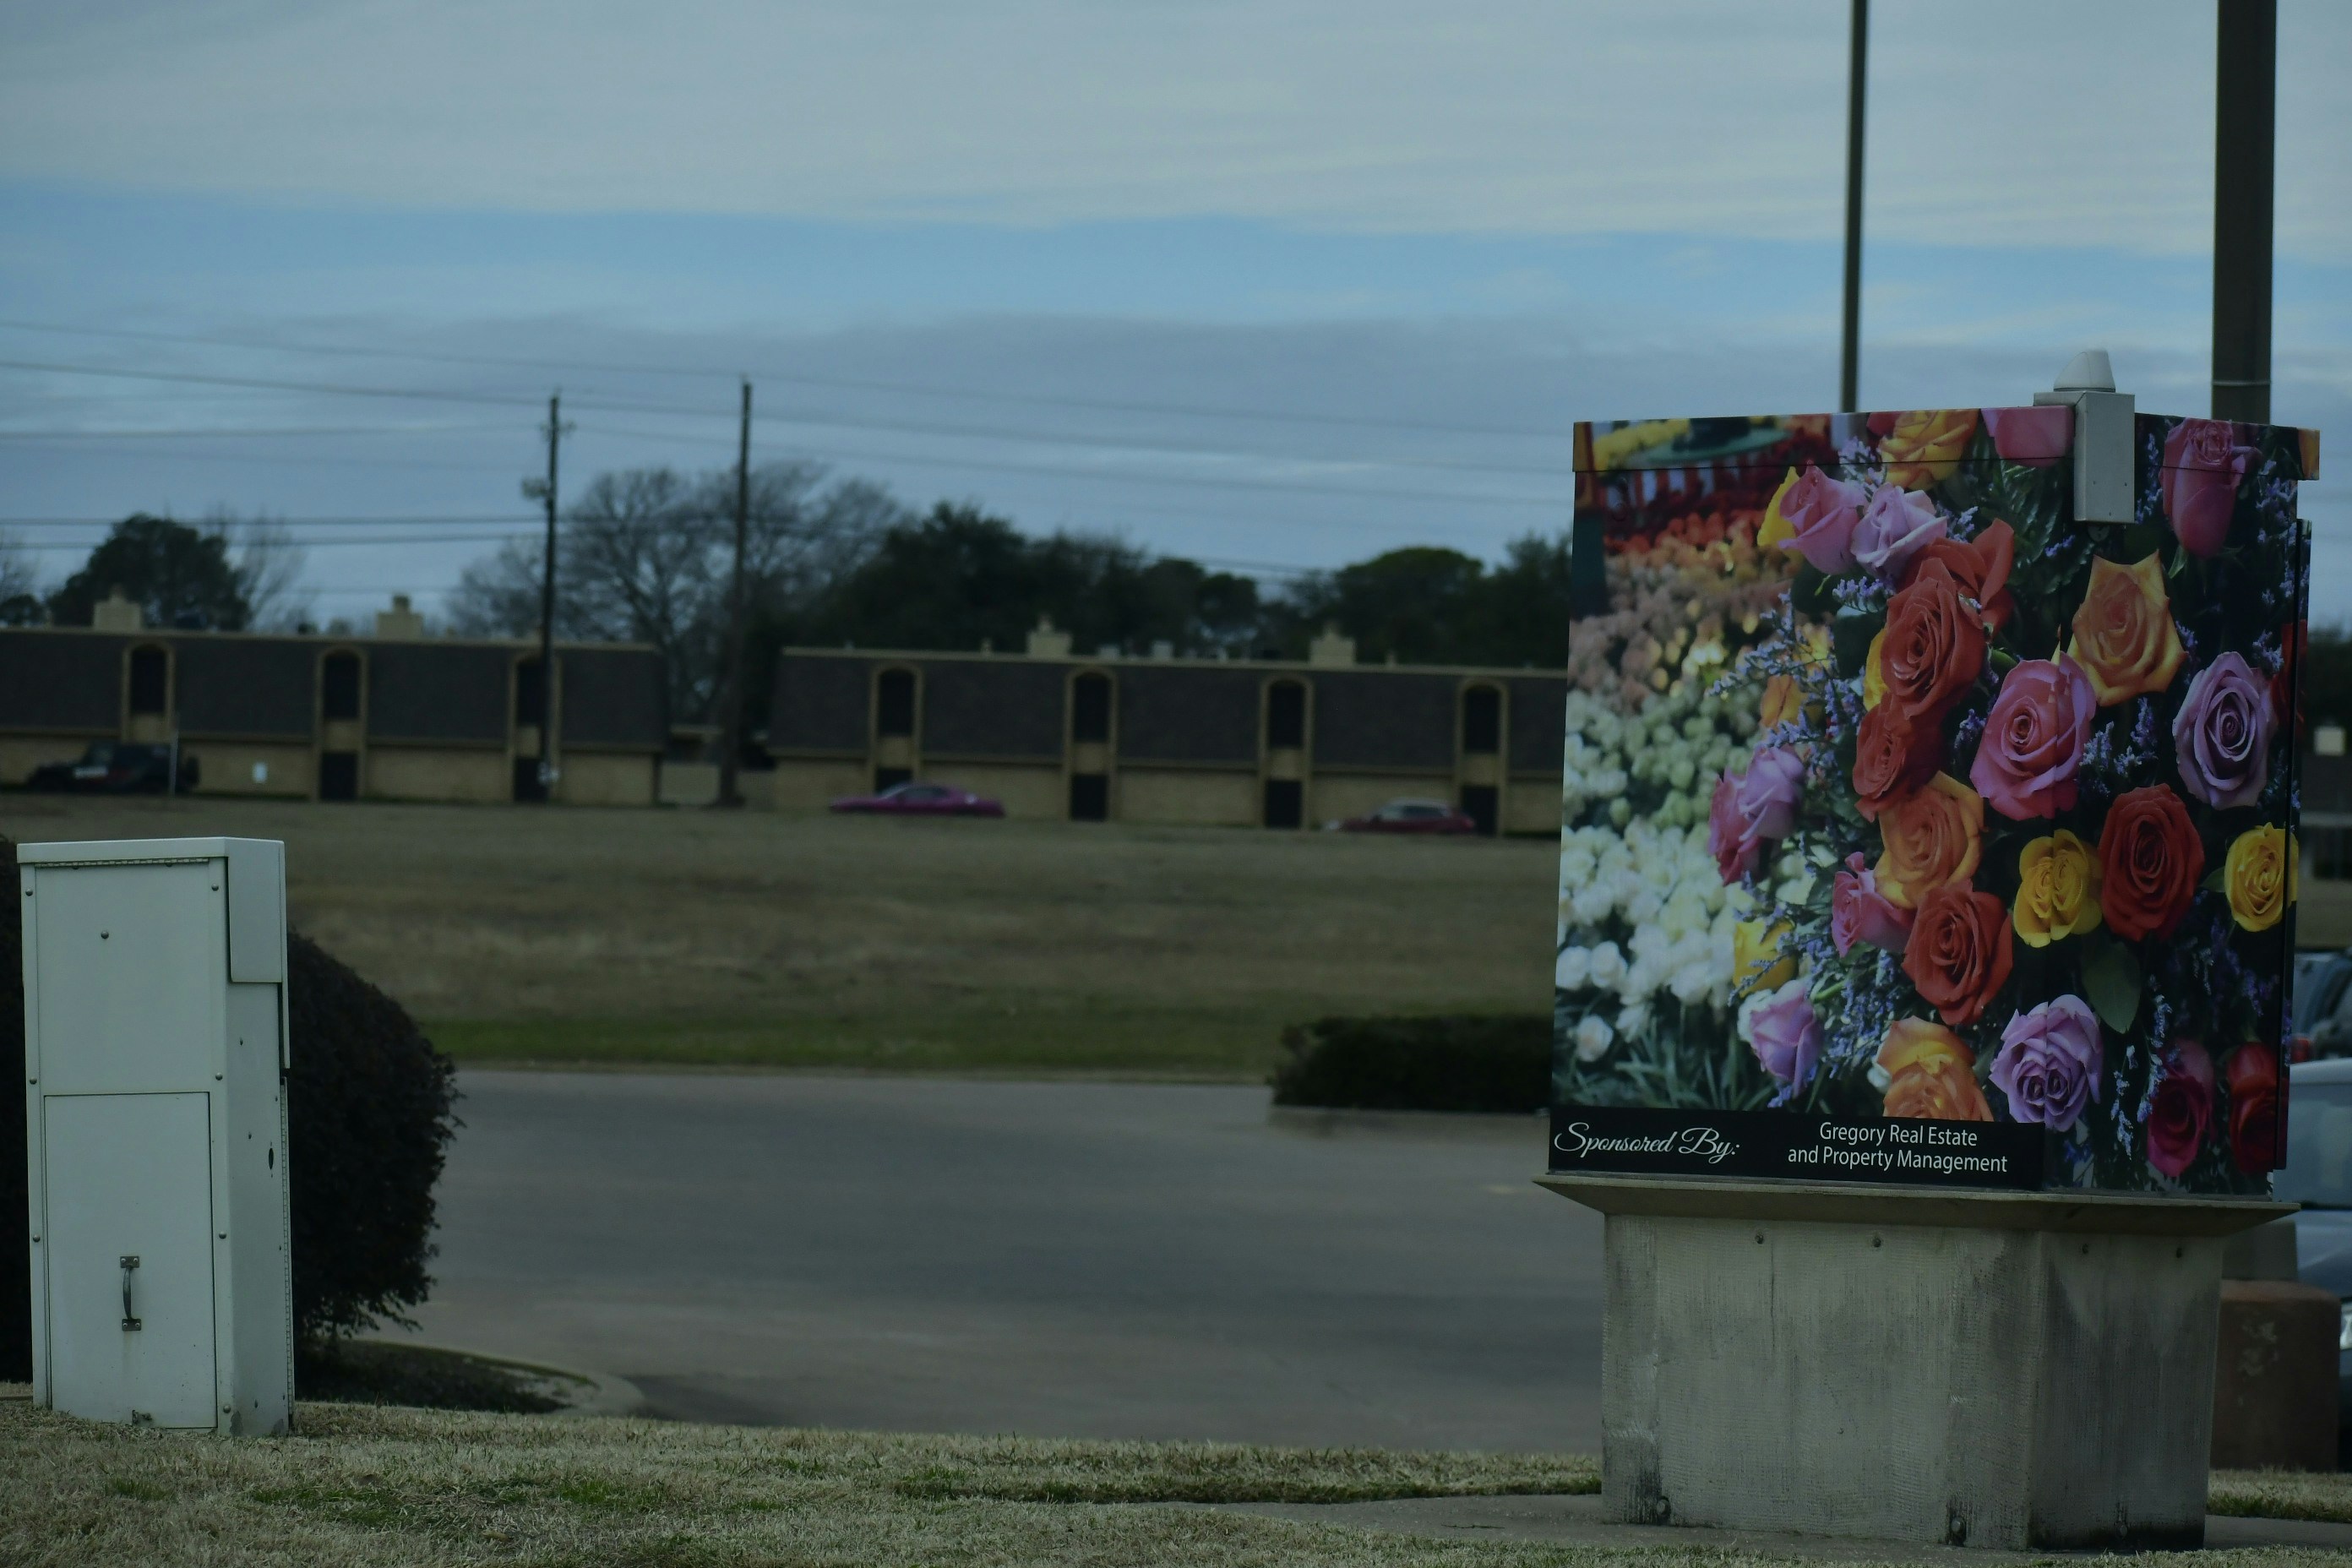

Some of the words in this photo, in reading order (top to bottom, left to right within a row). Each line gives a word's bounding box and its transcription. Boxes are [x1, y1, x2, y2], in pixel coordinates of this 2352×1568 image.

[1554, 1122, 1678, 1159] Sponsored
[1678, 1127, 1740, 1163] By:
[1820, 1121, 1885, 1147] Gregory
[1890, 1124, 1924, 1144] Real
[1928, 1126, 1978, 1146] Estate
[1788, 1146, 1819, 1163] and
[1823, 1146, 1892, 1172] Property
[1897, 1150, 2008, 1173] Management
